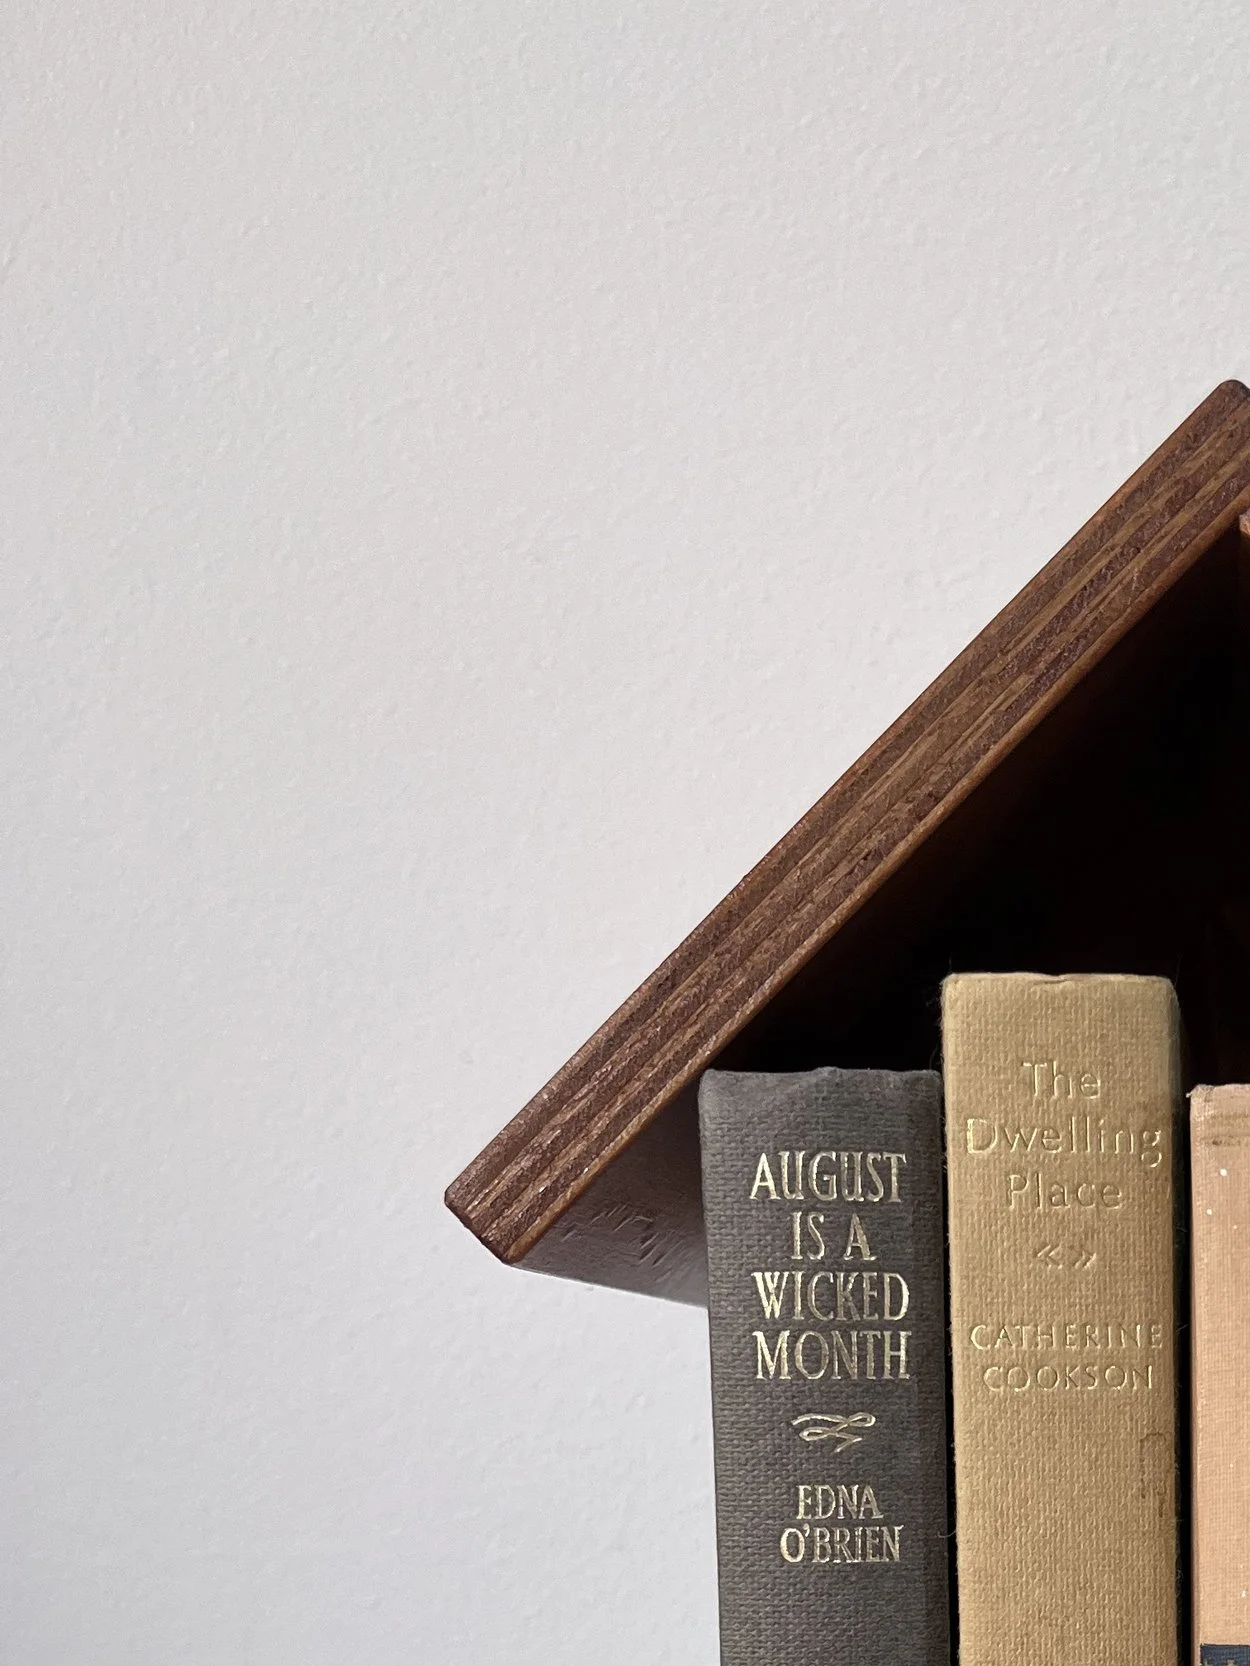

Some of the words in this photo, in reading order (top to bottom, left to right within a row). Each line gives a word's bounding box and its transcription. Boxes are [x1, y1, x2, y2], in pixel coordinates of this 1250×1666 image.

[1021, 1060, 1101, 1099] The
[966, 1116, 1162, 1168] Dwelling
[749, 1151, 906, 1202] AUGUST
[1008, 1173, 1123, 1209] Place
[791, 1212, 824, 1260] IS
[844, 1213, 877, 1260] A
[751, 1271, 909, 1321] WICKED
[752, 1330, 911, 1380] MONTH
[970, 1324, 1163, 1350] CATHERINE
[983, 1365, 1153, 1392] COOKSON
[797, 1484, 883, 1520] EDNA
[780, 1524, 904, 1563] O'BRIEN
